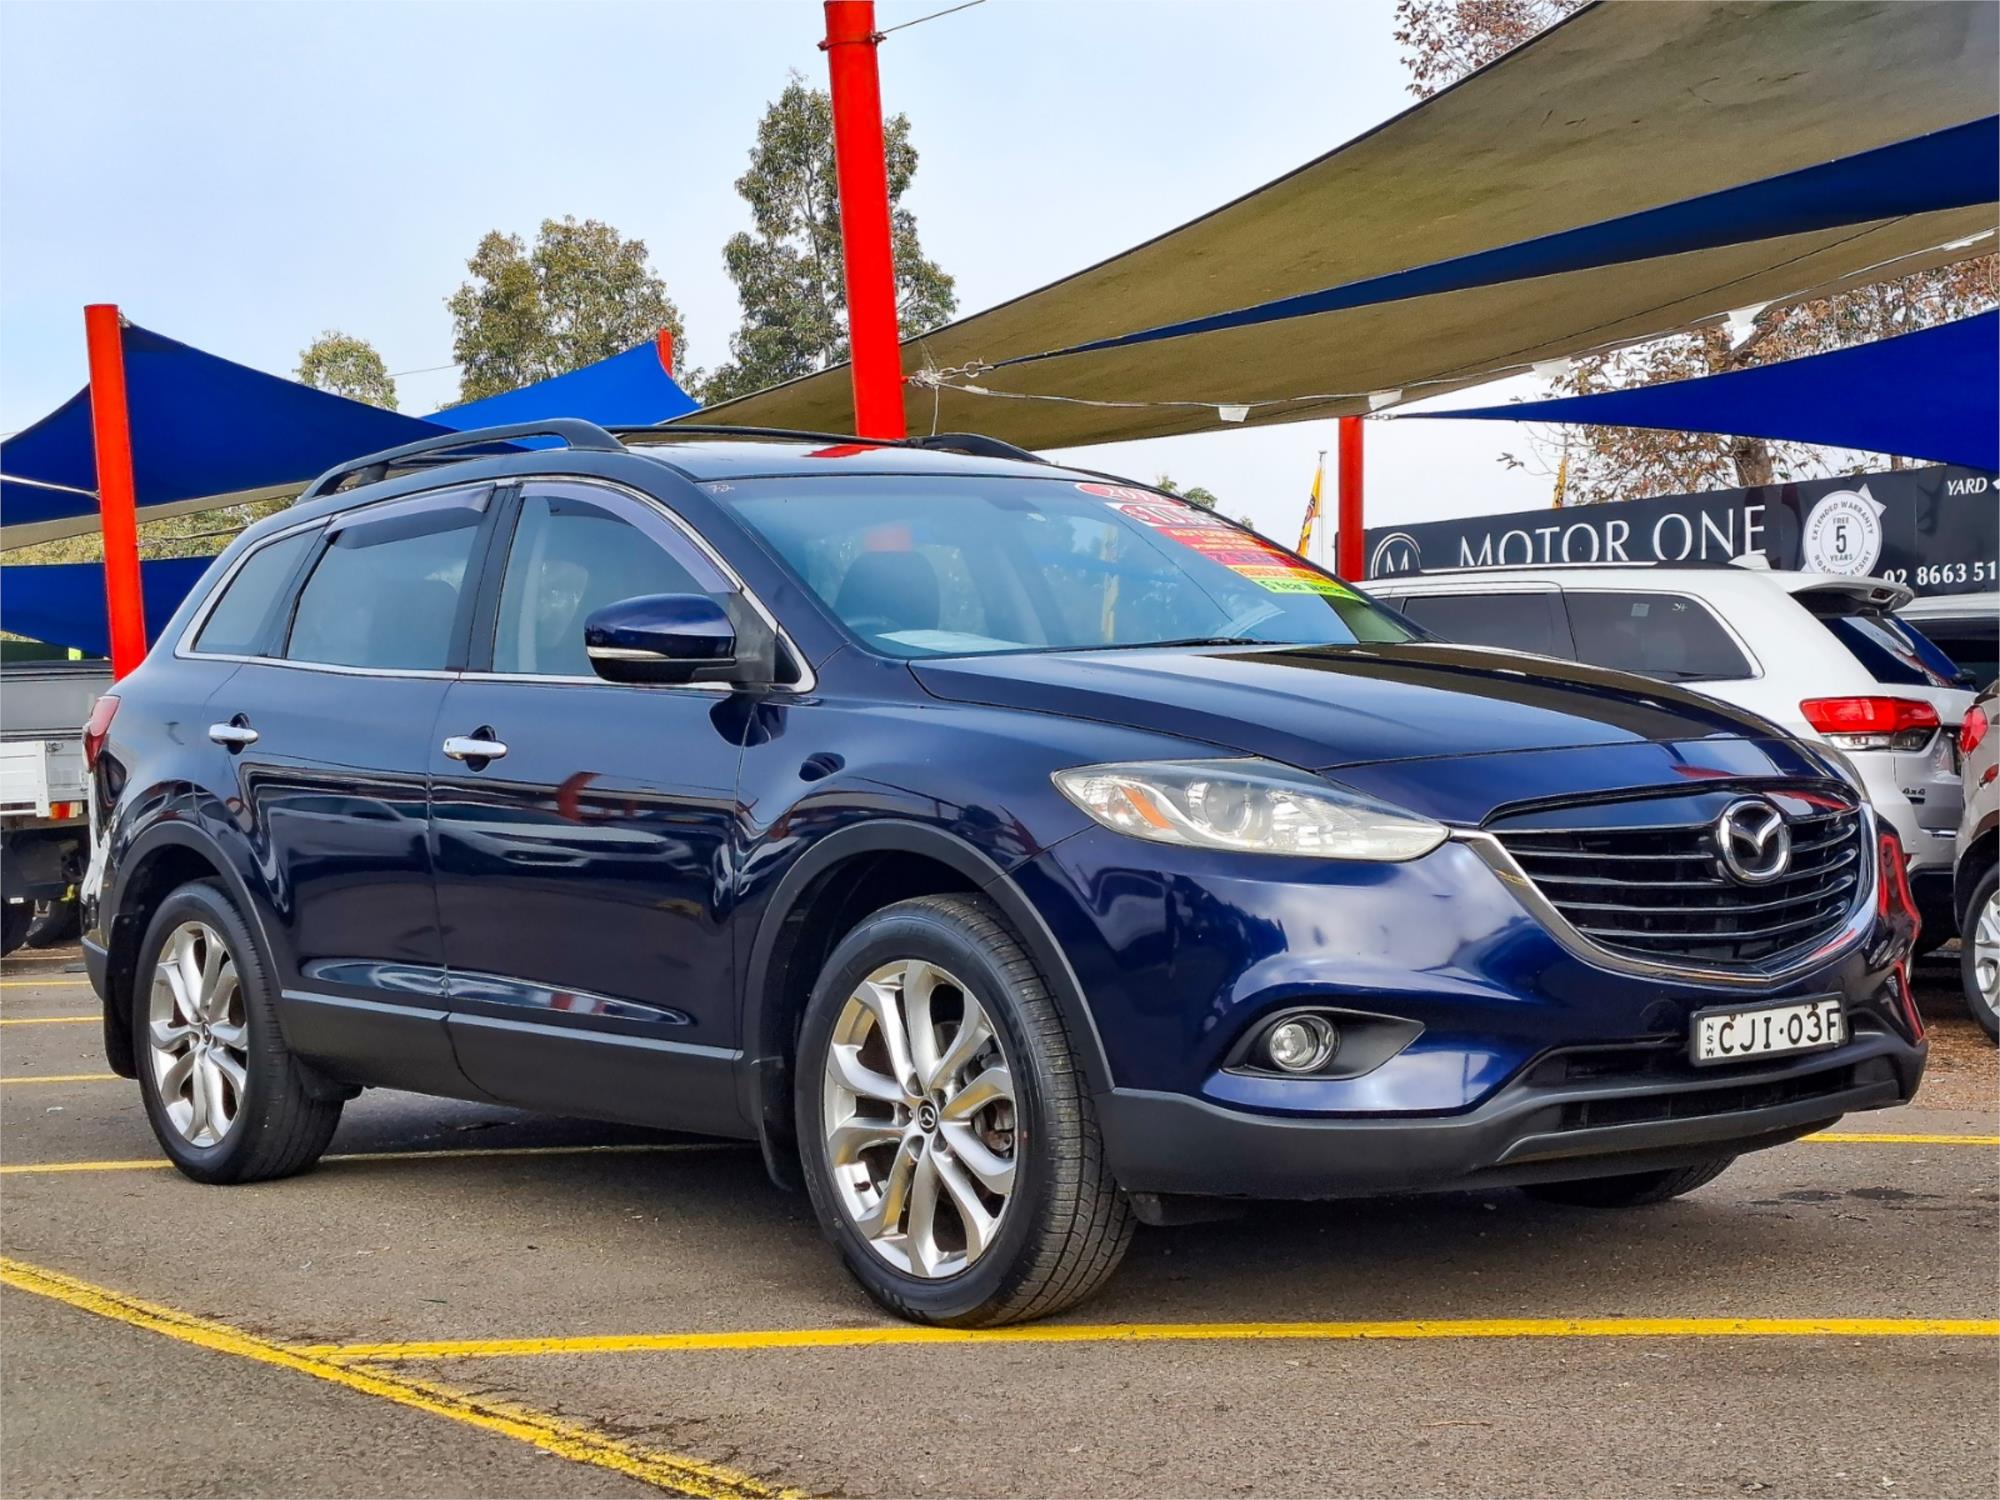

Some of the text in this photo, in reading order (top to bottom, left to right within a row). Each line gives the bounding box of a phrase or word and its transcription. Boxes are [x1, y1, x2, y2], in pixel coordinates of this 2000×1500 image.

[1946, 476, 1988, 496] YARD
[1811, 500, 1874, 541] EXTENDED WARRANTY
[1832, 516, 1850, 525] FREE
[1459, 504, 1767, 567] MOTOR ONE
[1835, 525, 1847, 554] 5
[1829, 553, 1853, 561] YEARS
[1882, 560, 1997, 586] 02 8663 51
